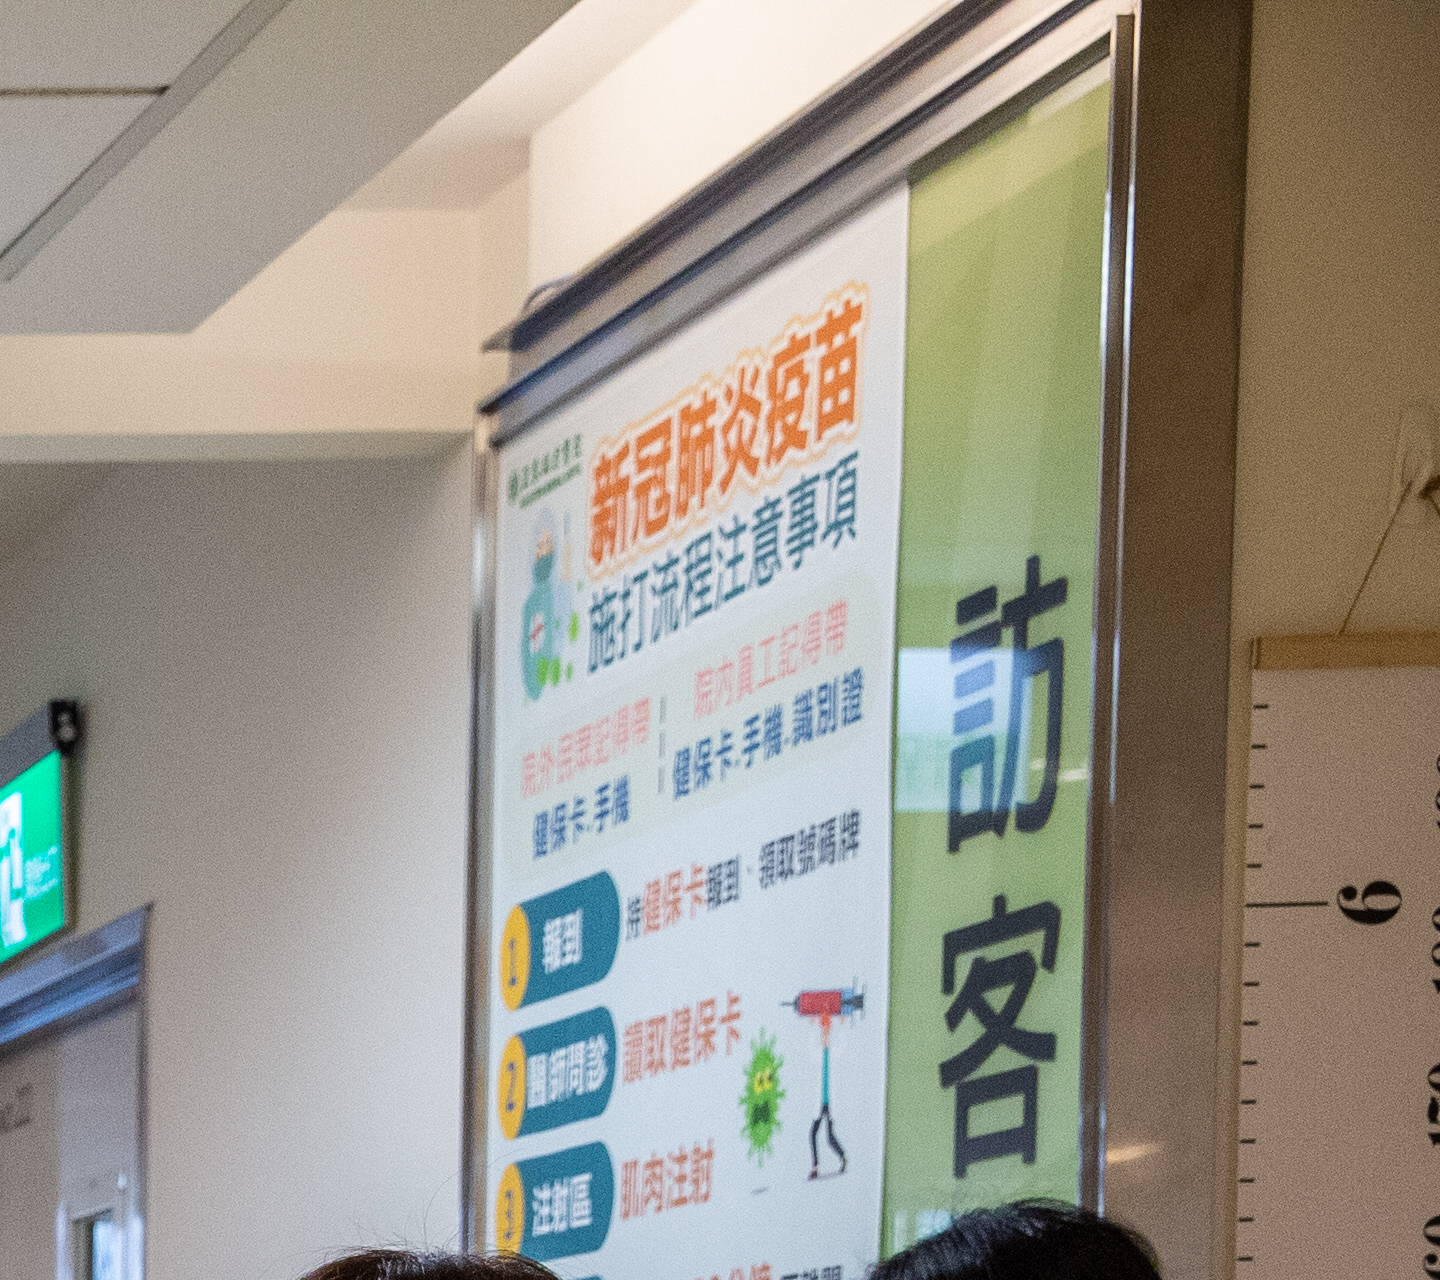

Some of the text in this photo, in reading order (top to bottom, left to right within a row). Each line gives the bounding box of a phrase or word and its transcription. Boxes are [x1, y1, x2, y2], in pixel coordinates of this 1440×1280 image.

[590, 299, 864, 566] 新冠肺炎疫苗
[587, 449, 859, 675] 施打流程注意事項
[1337, 880, 1403, 925] 6
[619, 1137, 716, 1221] 肌肉注射
